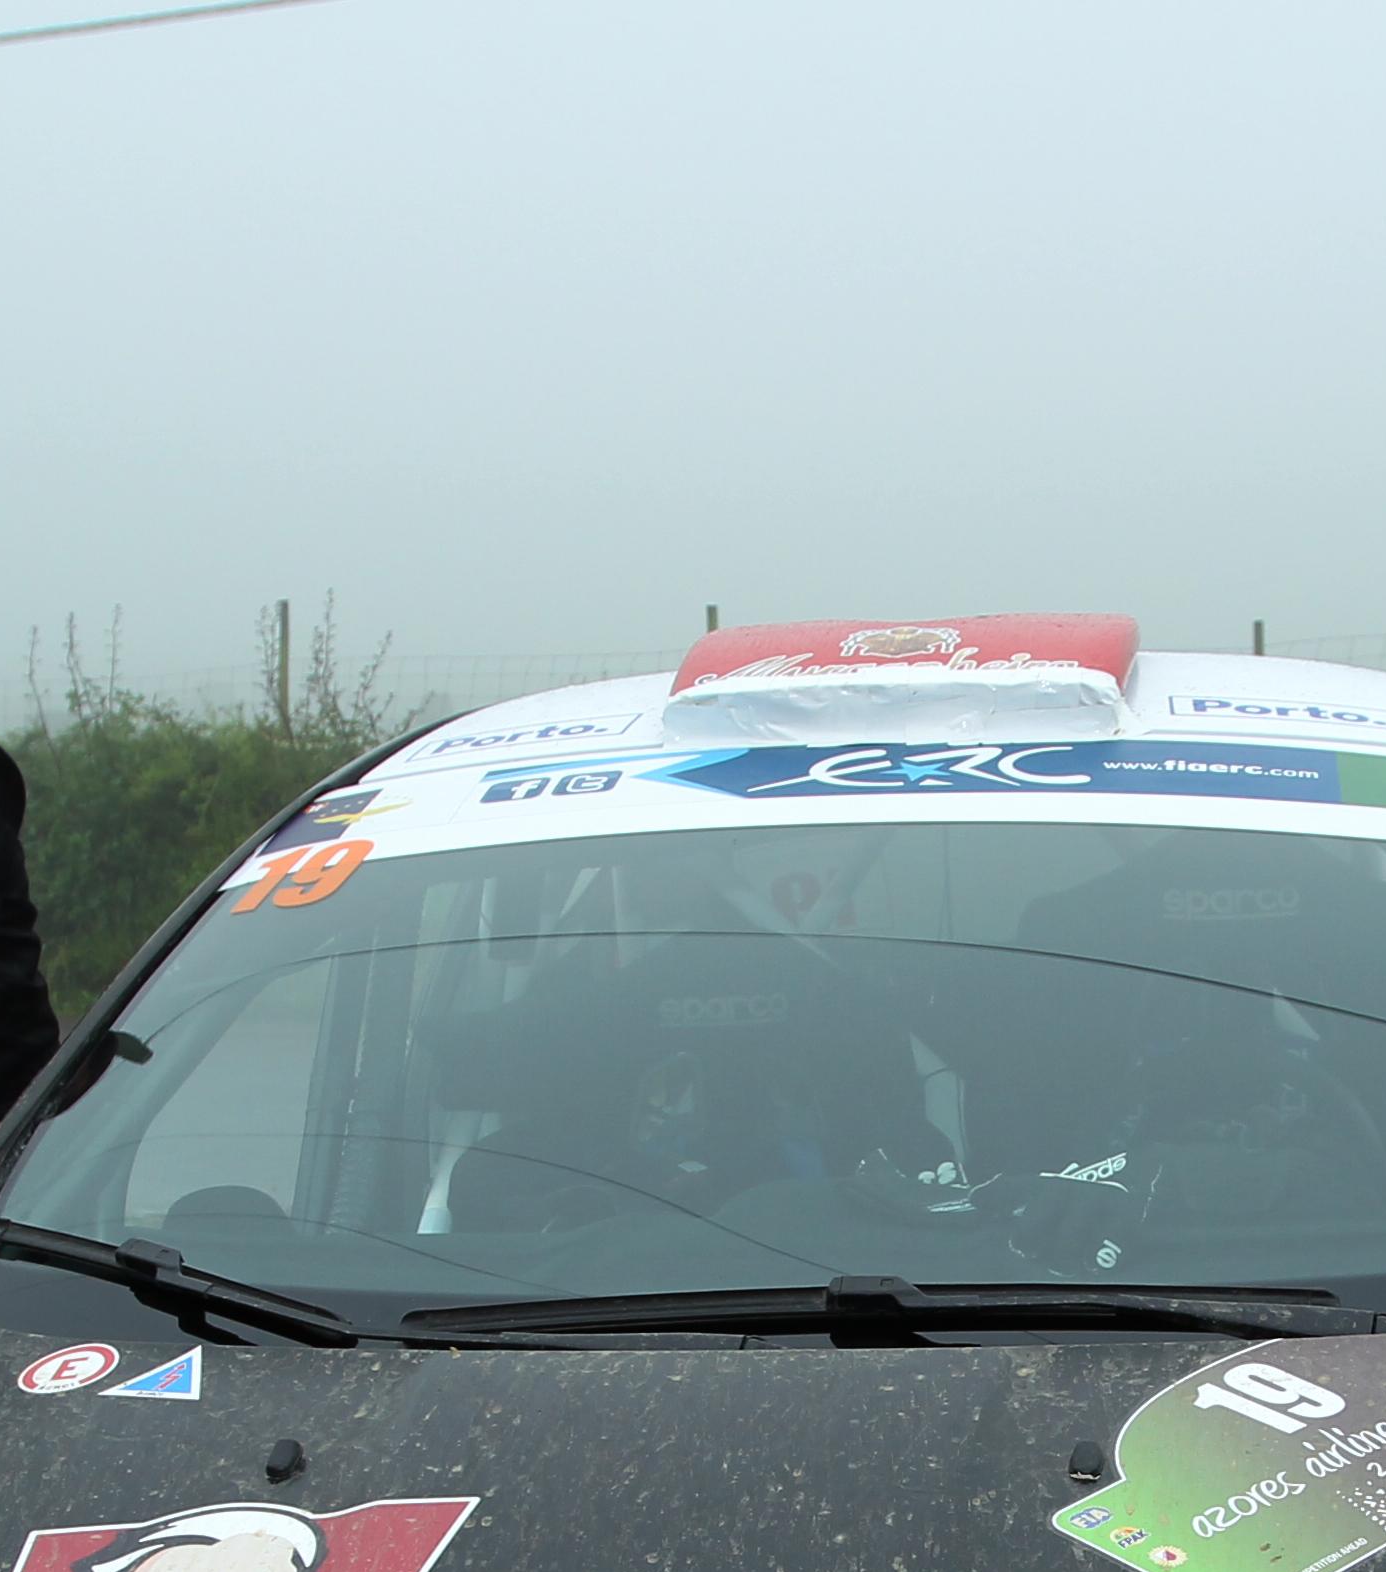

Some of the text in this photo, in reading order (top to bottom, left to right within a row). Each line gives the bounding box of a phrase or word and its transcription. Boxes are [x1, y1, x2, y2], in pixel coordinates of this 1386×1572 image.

[1103, 760, 1320, 780] www.fiaerc.com
[230, 839, 376, 916] 19
[50, 1357, 89, 1381] E
[1193, 1363, 1346, 1434] 19
[1191, 1471, 1306, 1538] azores
